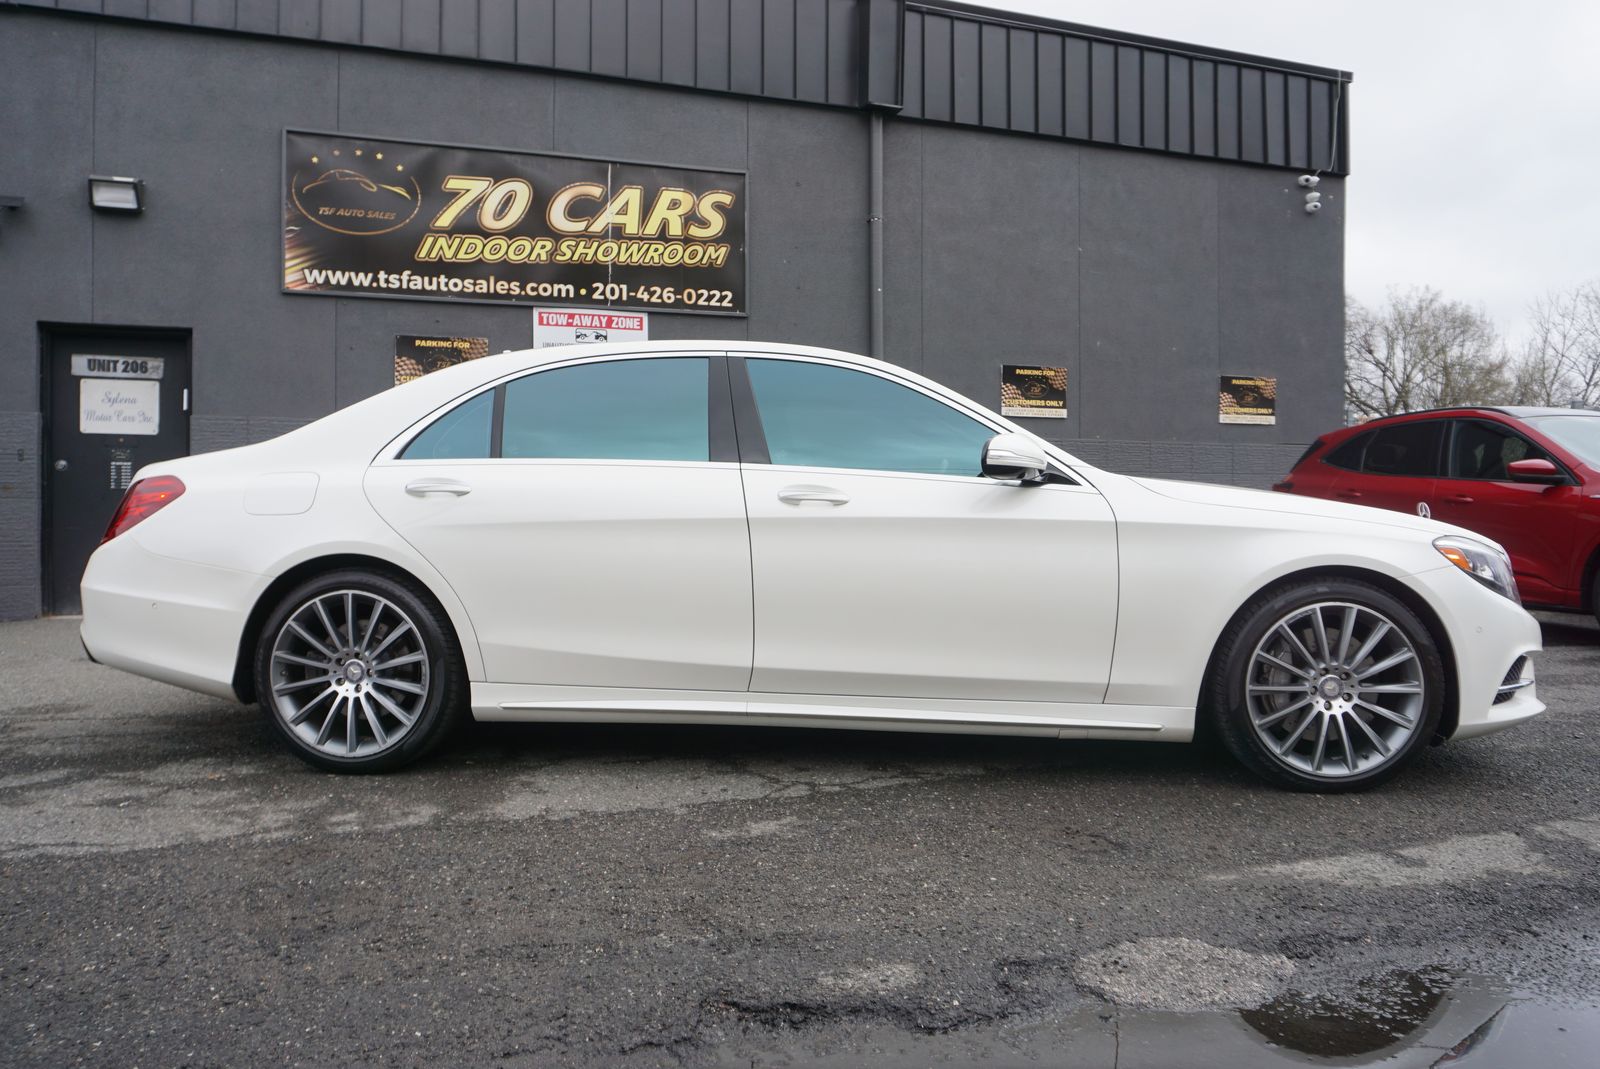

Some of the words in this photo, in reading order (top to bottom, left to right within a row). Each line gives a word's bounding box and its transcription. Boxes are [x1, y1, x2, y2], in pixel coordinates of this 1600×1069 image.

[318, 207, 335, 215] TSF
[336, 208, 365, 218] AUTO
[366, 210, 397, 220] SALES
[431, 176, 532, 232] 70
[547, 182, 735, 239] CARS
[415, 233, 554, 264] INDOOR
[553, 238, 731, 268] SHOWROOM
[303, 268, 575, 298] www.tsfautosales.com
[591, 282, 733, 307] 201-426-0222
[541, 313, 608, 328] TOW-AWAY
[611, 317, 641, 329] ZONE
[415, 339, 452, 348] PARKING
[453, 340, 471, 349] FOR
[87, 358, 119, 372] UNIT
[121, 360, 148, 374] 206
[1005, 399, 1046, 407] CUSTOMERS
